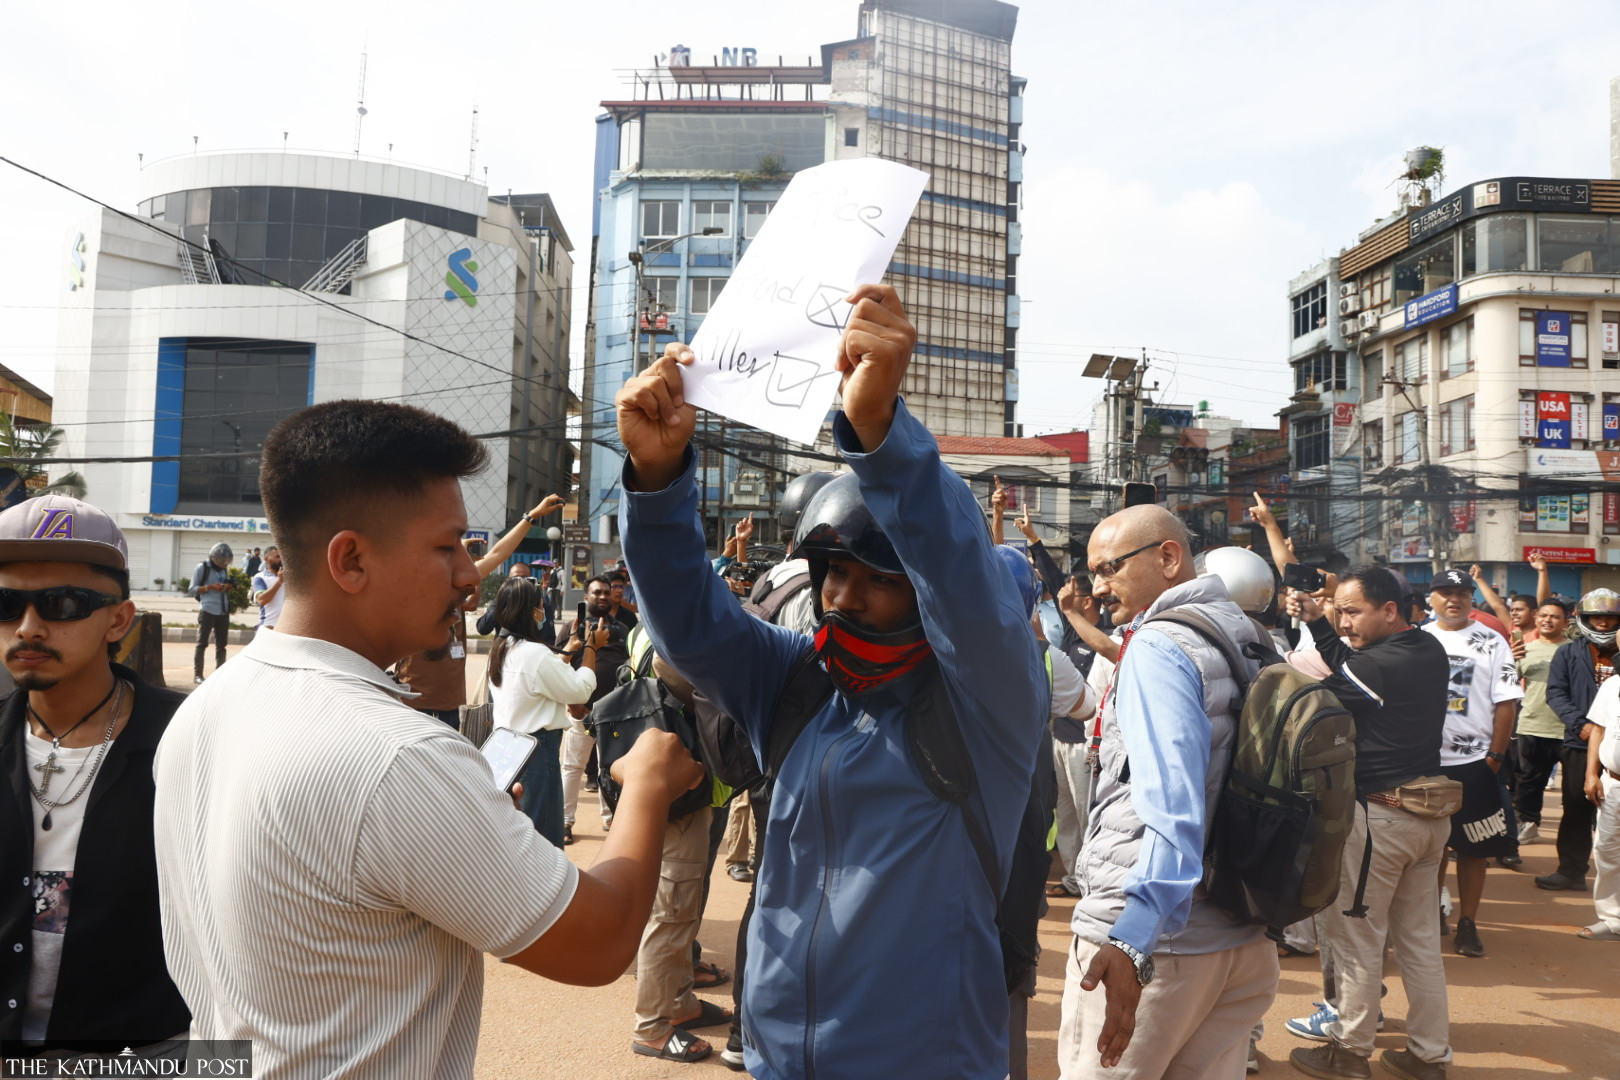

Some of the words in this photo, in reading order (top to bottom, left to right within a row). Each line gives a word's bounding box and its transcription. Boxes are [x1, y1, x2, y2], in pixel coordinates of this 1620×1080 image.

[1532, 184, 1572, 195] TERRACE
[1420, 202, 1452, 226] TERRACE
[1419, 291, 1450, 309] HARDFORD
[1419, 299, 1451, 316] EDUCATION
[1540, 400, 1567, 413] USA
[1544, 428, 1563, 440] UK
[142, 516, 190, 528] Standard
[192, 518, 244, 530] Chartered
